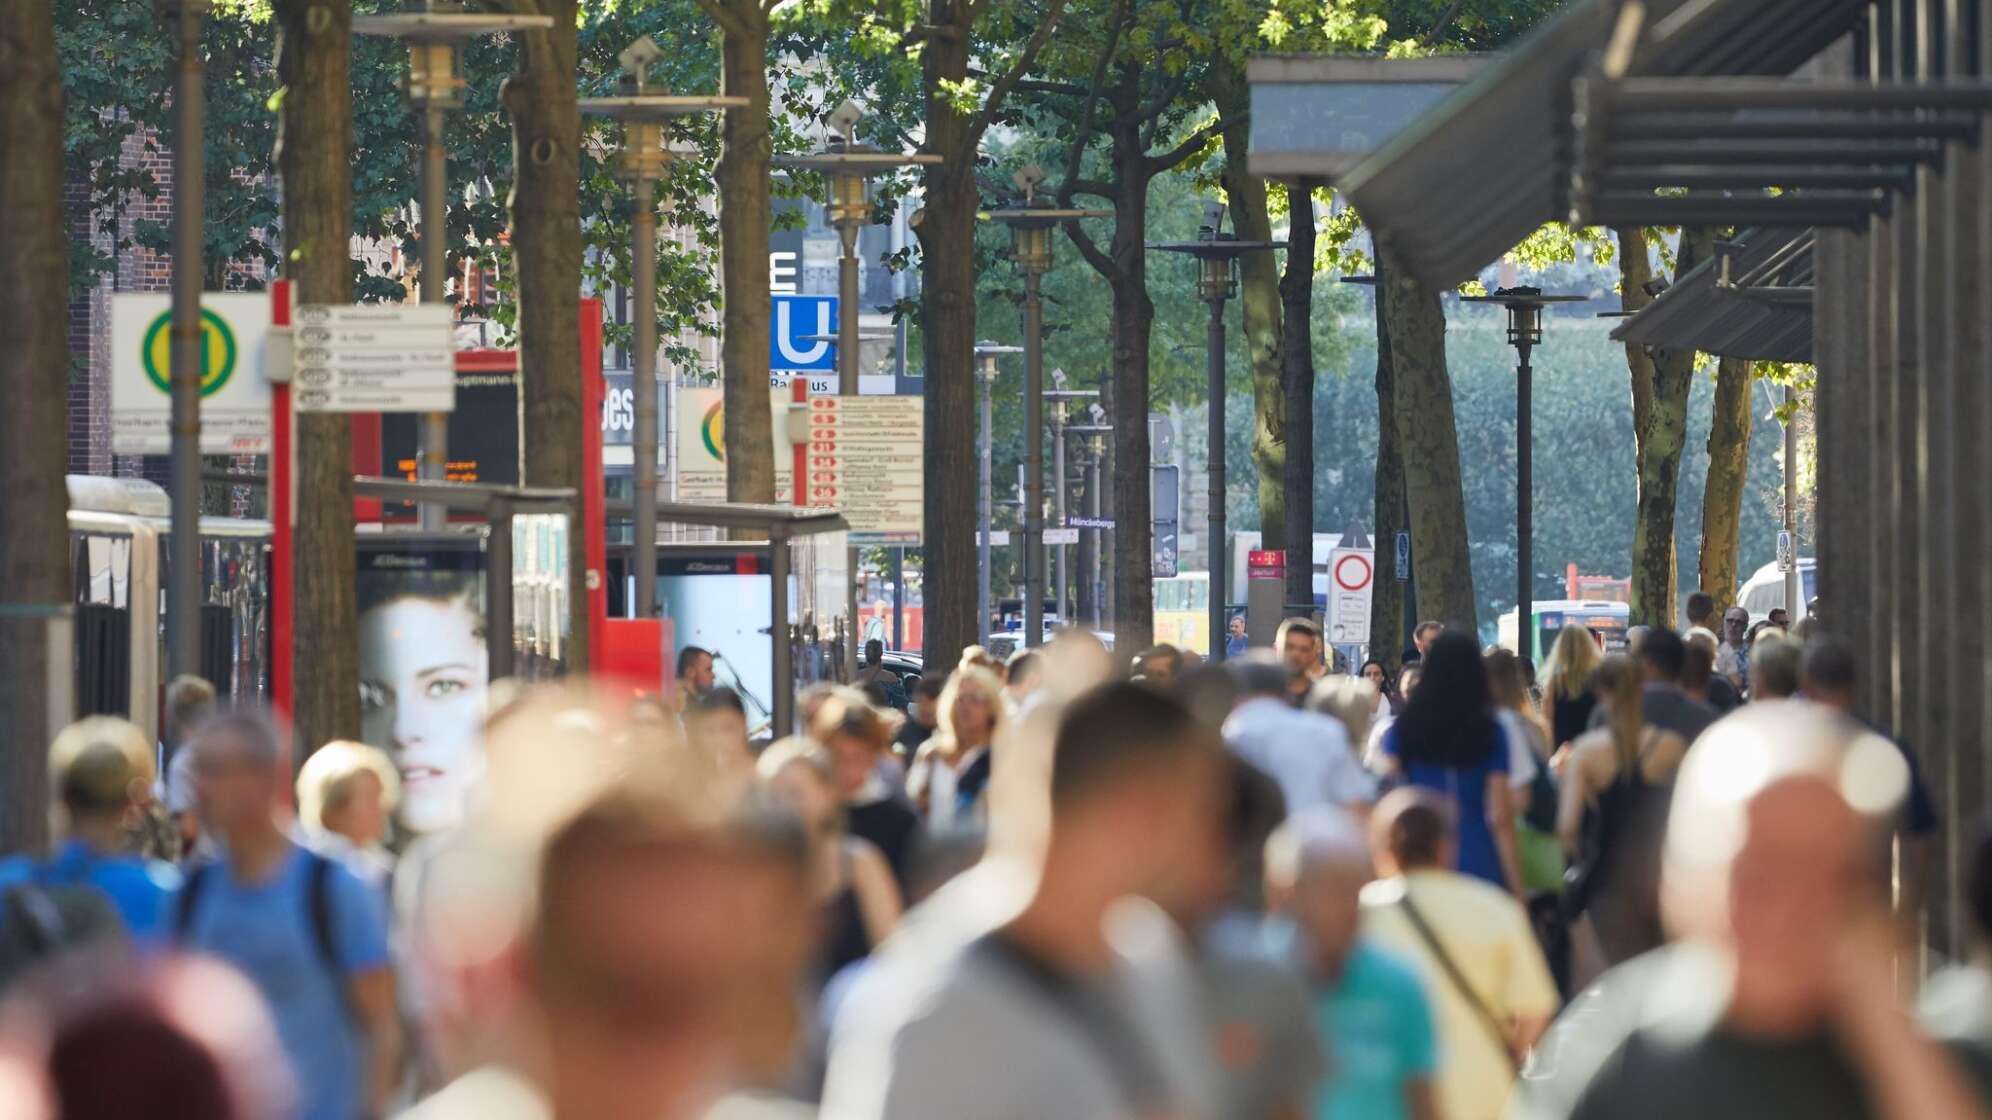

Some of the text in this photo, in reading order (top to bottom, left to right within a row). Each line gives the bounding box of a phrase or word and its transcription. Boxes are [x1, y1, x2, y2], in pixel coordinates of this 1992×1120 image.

[769, 252, 797, 292] E
[777, 301, 830, 364] U
[770, 378, 828, 391] Raus
